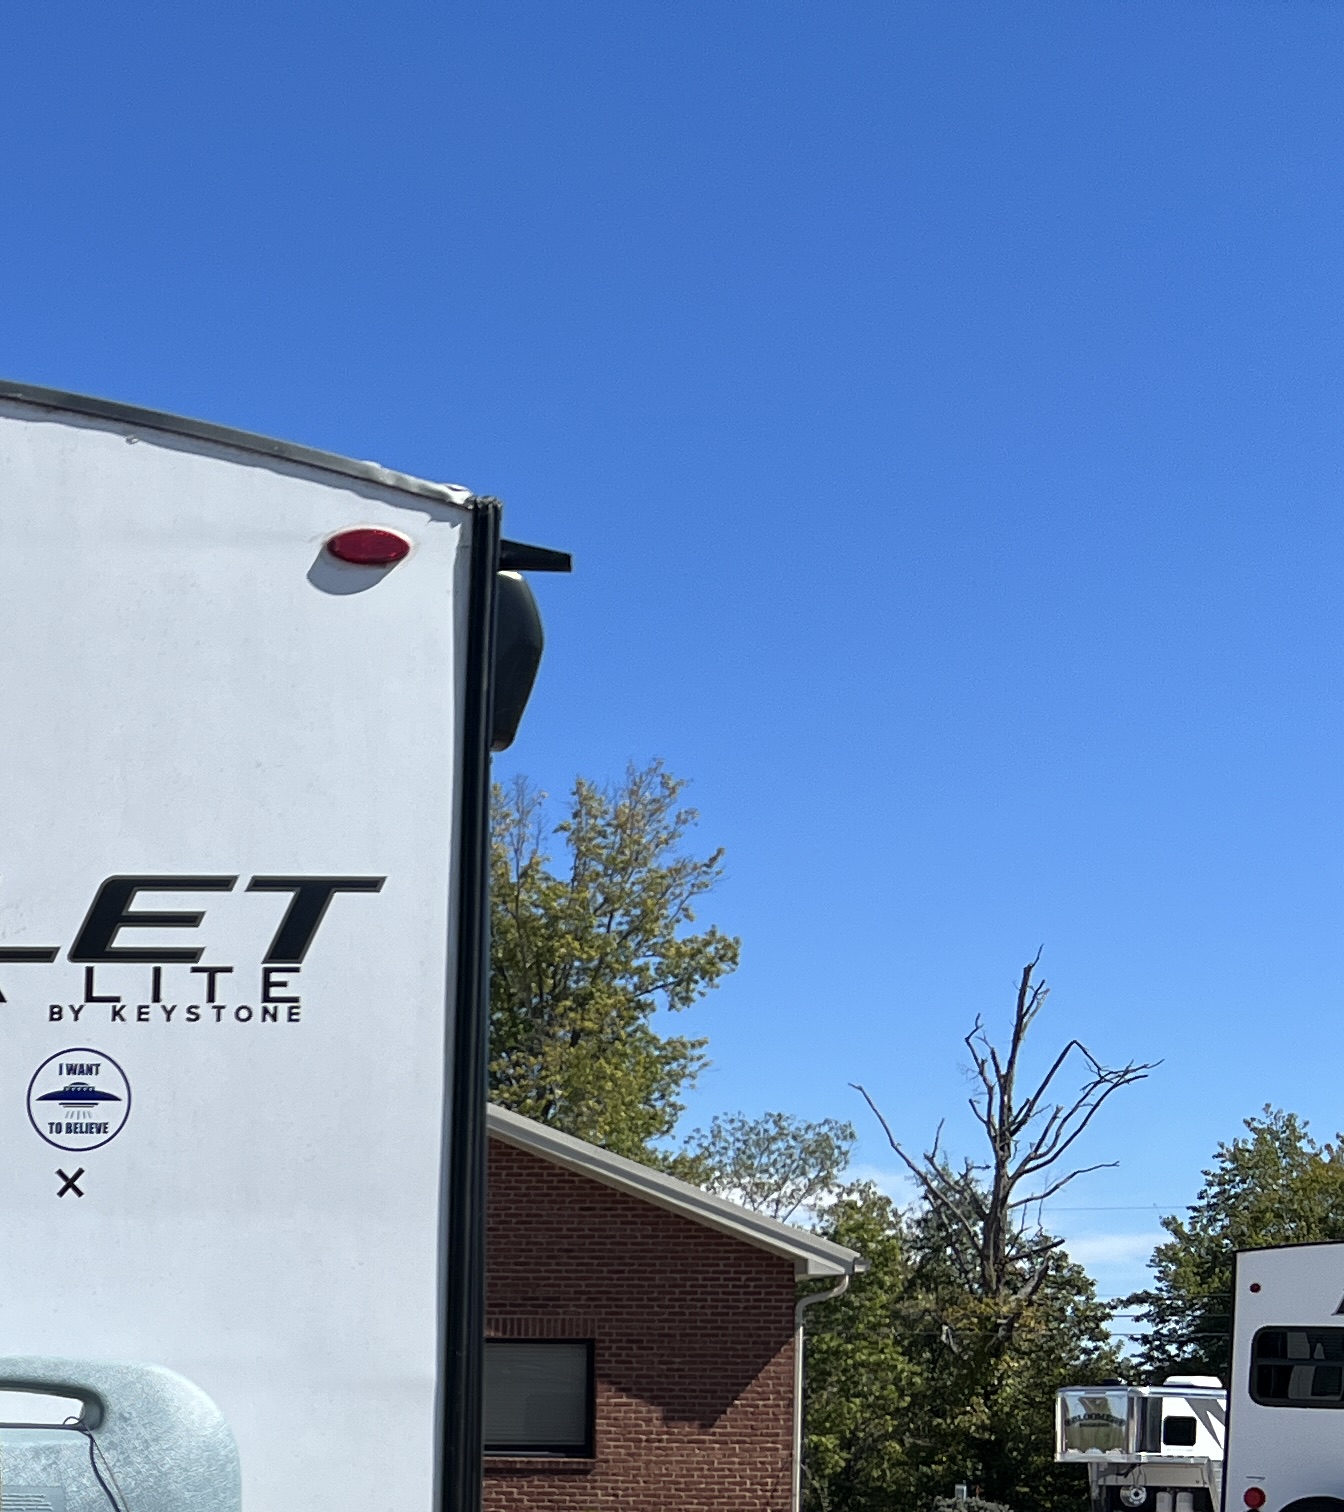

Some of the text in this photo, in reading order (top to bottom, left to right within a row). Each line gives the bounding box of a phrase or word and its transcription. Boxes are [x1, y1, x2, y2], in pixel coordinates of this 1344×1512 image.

[83, 966, 301, 1004] LITE
[49, 1005, 302, 1023] BY KEYSTONE
[58, 1063, 101, 1076] I WANT
[48, 1122, 110, 1134] TO BELIEVE
